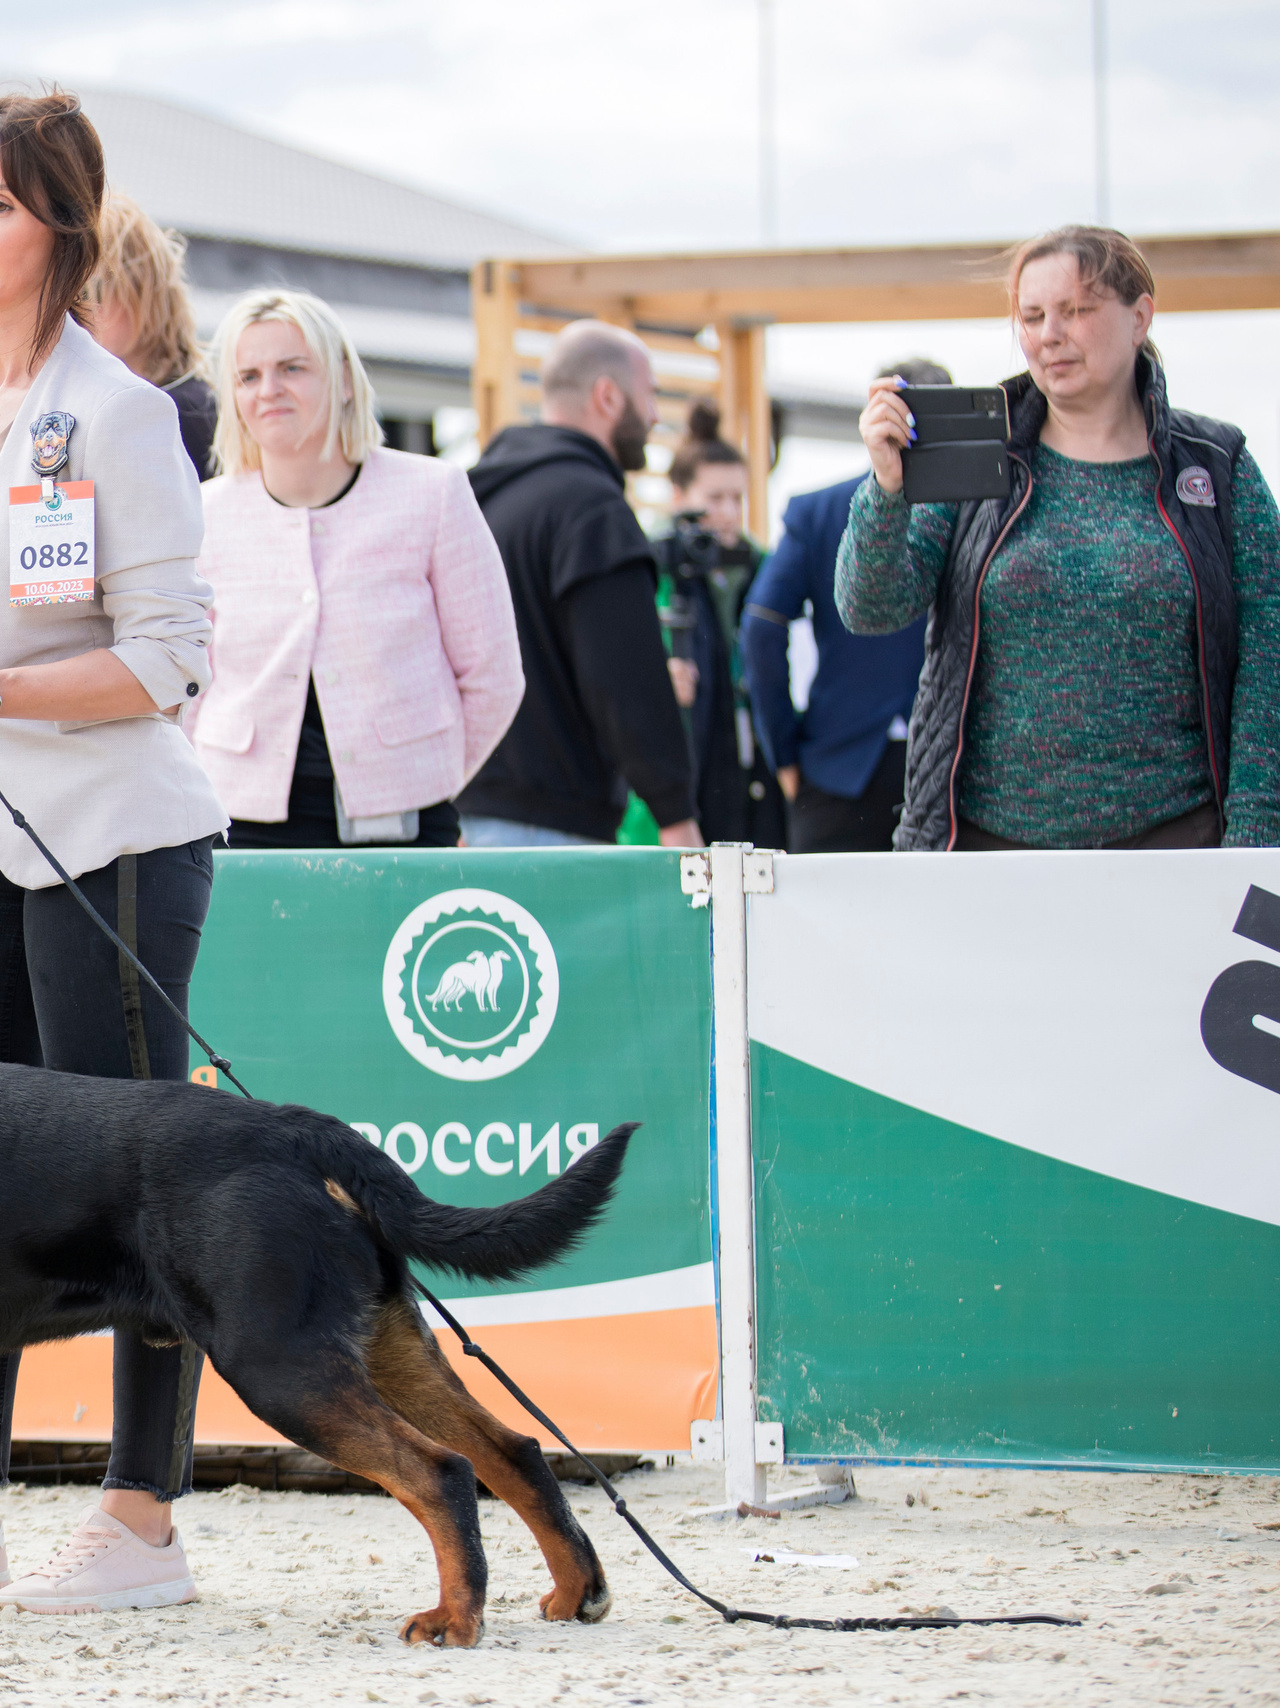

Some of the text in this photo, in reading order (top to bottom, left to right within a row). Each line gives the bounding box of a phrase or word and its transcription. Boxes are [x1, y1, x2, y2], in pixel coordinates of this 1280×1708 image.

[35, 512, 73, 523] РОССИЯ
[20, 541, 89, 570] 0882
[24, 580, 83, 596] 10.06.2023
